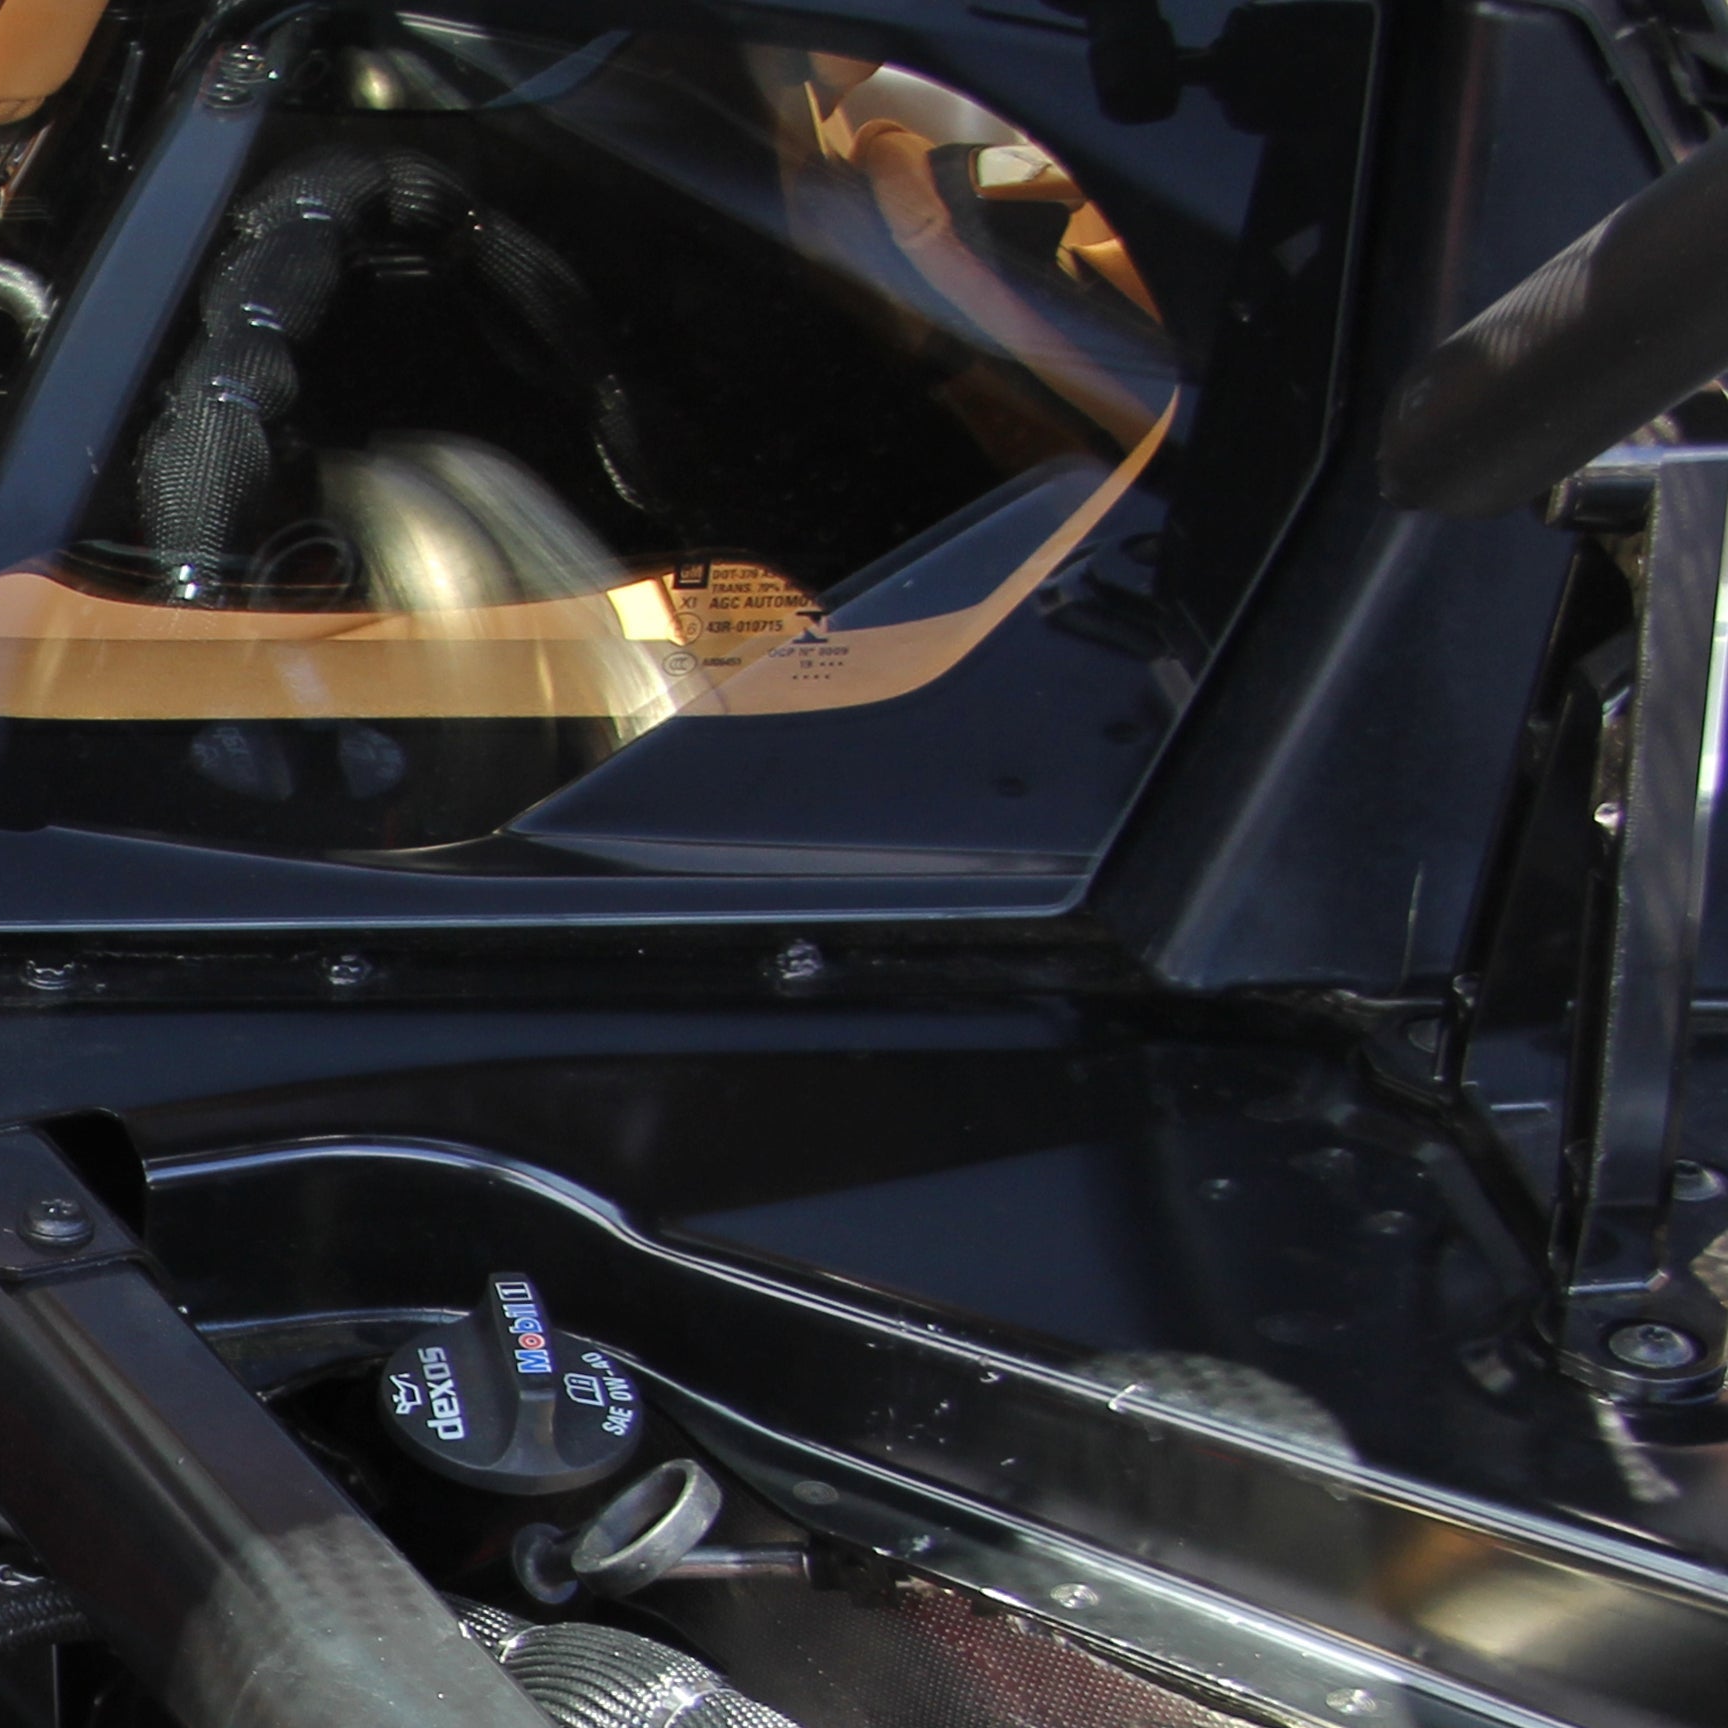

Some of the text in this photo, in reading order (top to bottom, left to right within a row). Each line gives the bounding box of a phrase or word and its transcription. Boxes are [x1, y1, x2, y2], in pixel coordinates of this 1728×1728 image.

[708, 596, 741, 609] AGC
[502, 1303, 552, 1374] Mobil
[418, 1345, 465, 1441] dexos
[580, 1352, 634, 1436] SAE 0W-40
